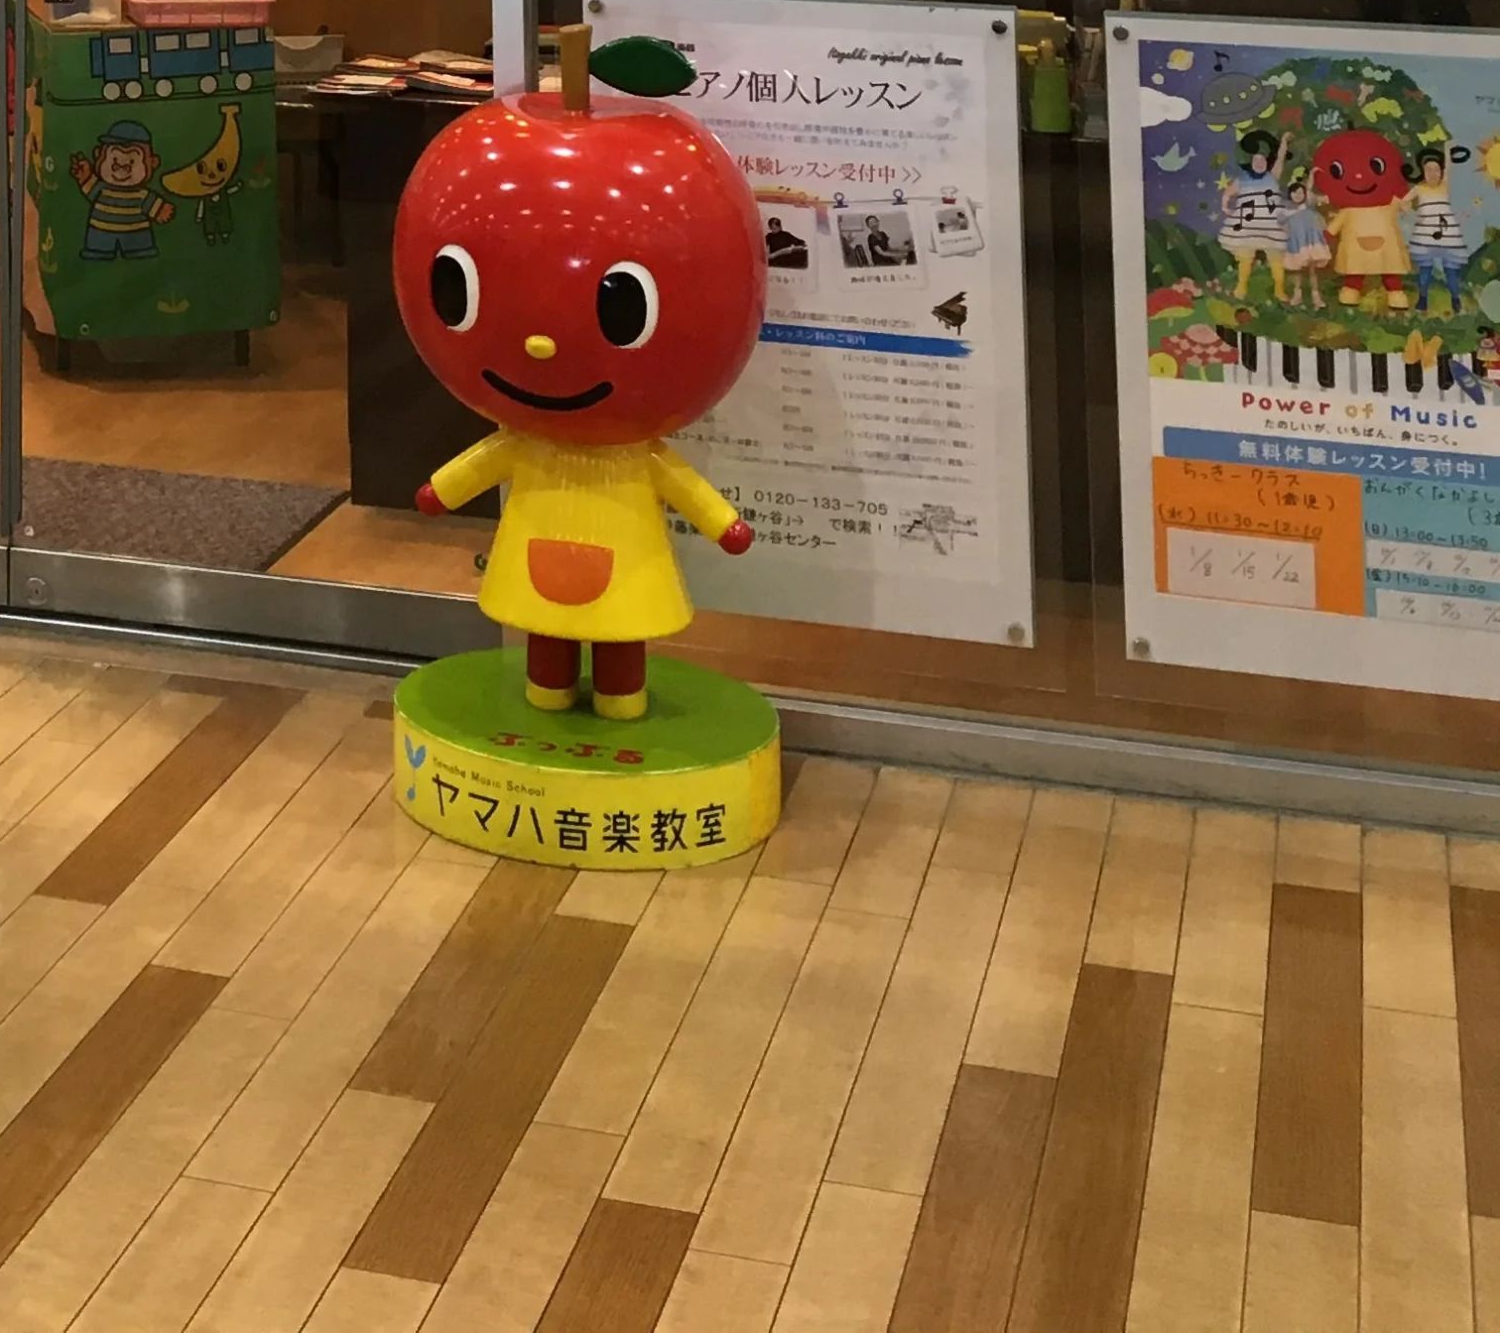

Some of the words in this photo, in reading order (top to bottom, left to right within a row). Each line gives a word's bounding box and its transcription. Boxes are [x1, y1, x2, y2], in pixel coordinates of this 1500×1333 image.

[678, 70, 924, 111] アノ個人レッスン
[1241, 392, 1331, 415] Power
[1344, 402, 1375, 419] of
[1390, 405, 1478, 429] Music
[1238, 439, 1487, 480] 無料体験レッスン受付中!
[506, 780, 546, 798] School
[431, 773, 727, 854] ヤマハ音楽教室
